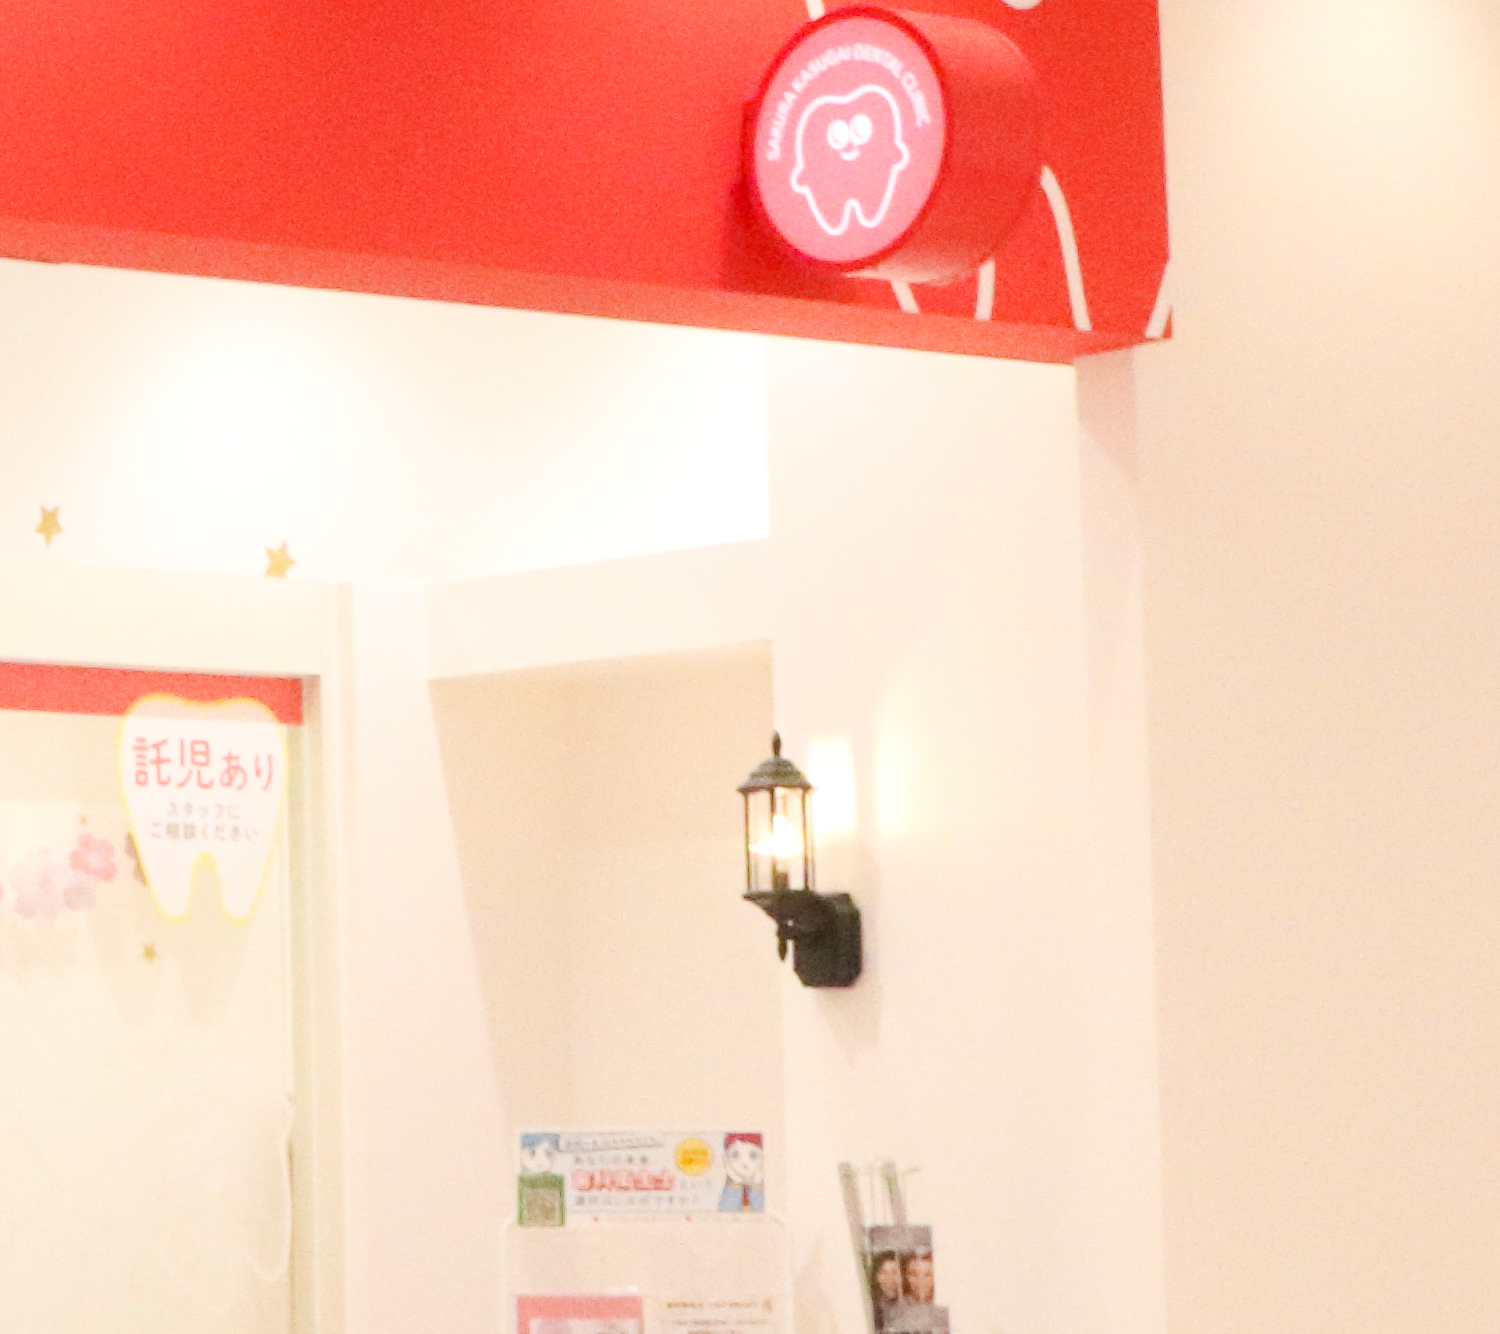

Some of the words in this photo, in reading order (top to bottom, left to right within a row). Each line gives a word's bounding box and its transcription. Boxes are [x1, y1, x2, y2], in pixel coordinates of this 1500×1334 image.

[767, 90, 796, 160] SAKURA
[133, 738, 273, 791] 託児あり
